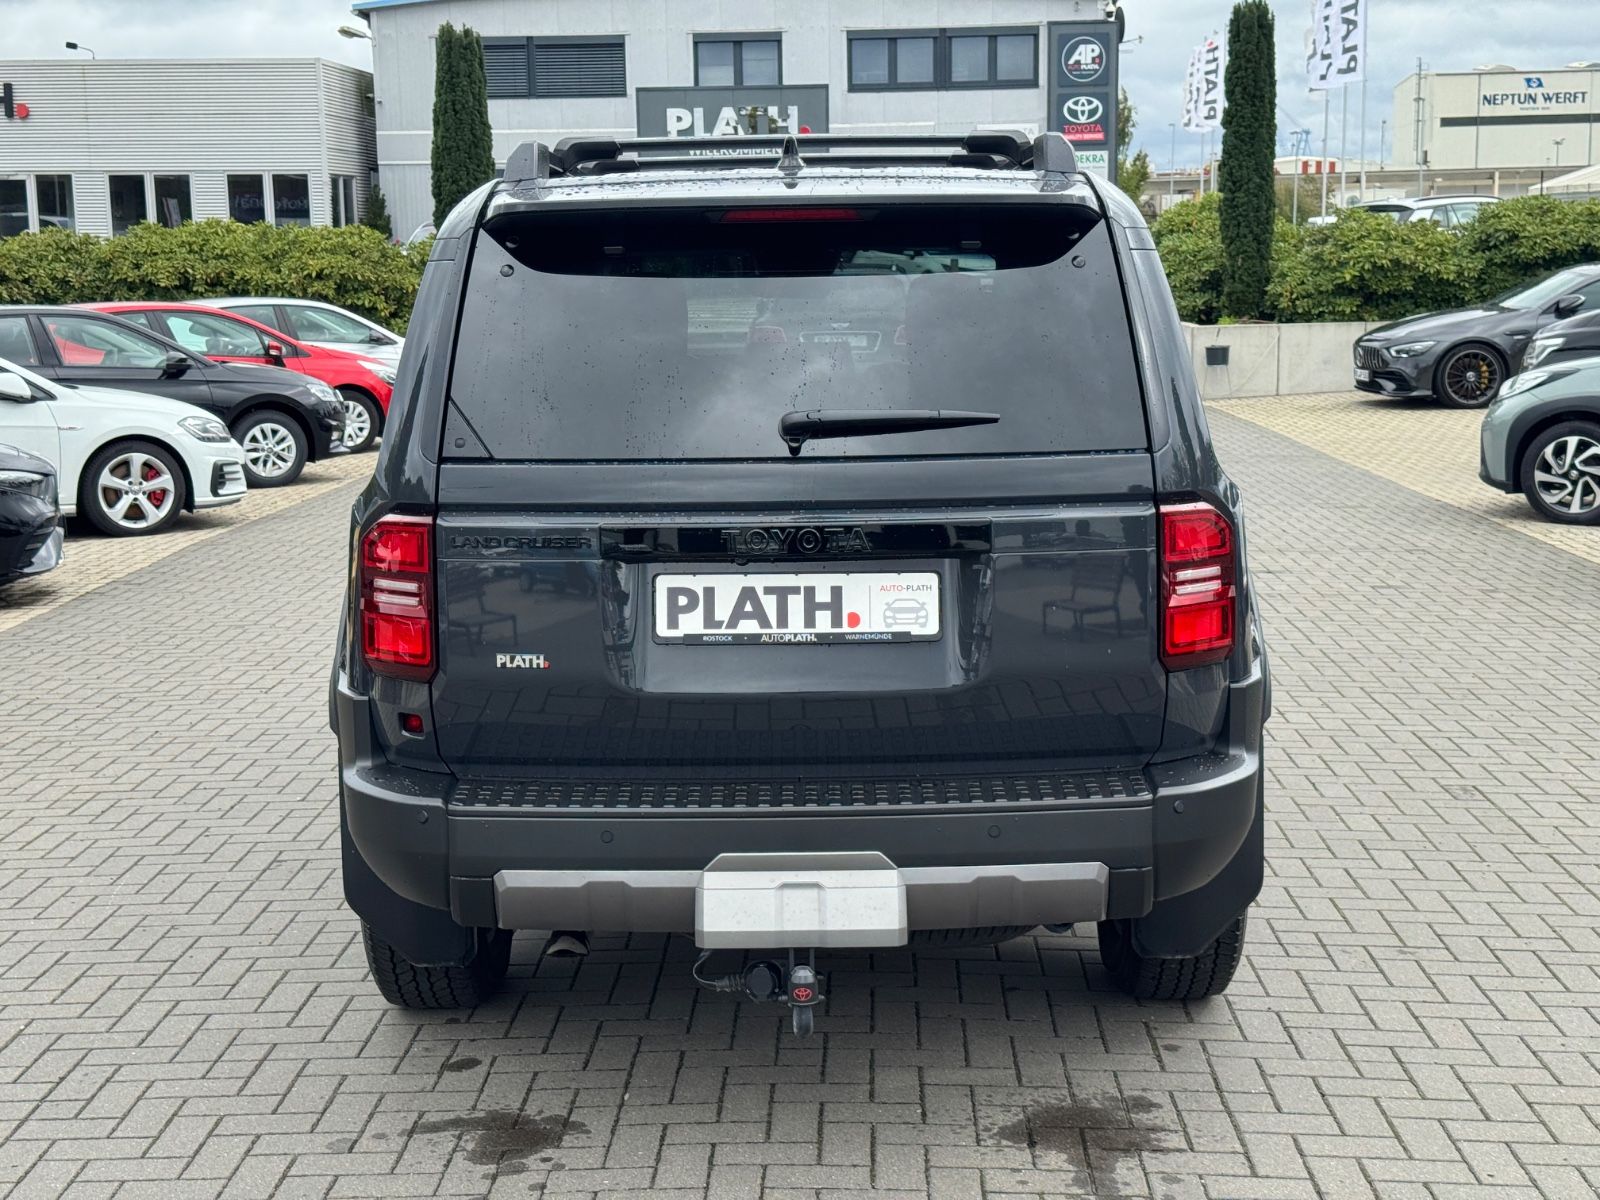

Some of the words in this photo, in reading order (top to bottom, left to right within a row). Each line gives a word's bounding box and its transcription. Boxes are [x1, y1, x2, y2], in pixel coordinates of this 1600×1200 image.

[1482, 93, 1537, 106] NEPTUN
[1542, 91, 1588, 104] WERFT
[1063, 124, 1102, 132] TOYOTA
[450, 535, 501, 549] LAND
[504, 535, 592, 549] CRUISER
[721, 527, 871, 555] TOYOTA
[879, 584, 932, 592] AUTO-PLATH
[845, 633, 892, 641] WARNEMÜNDE
